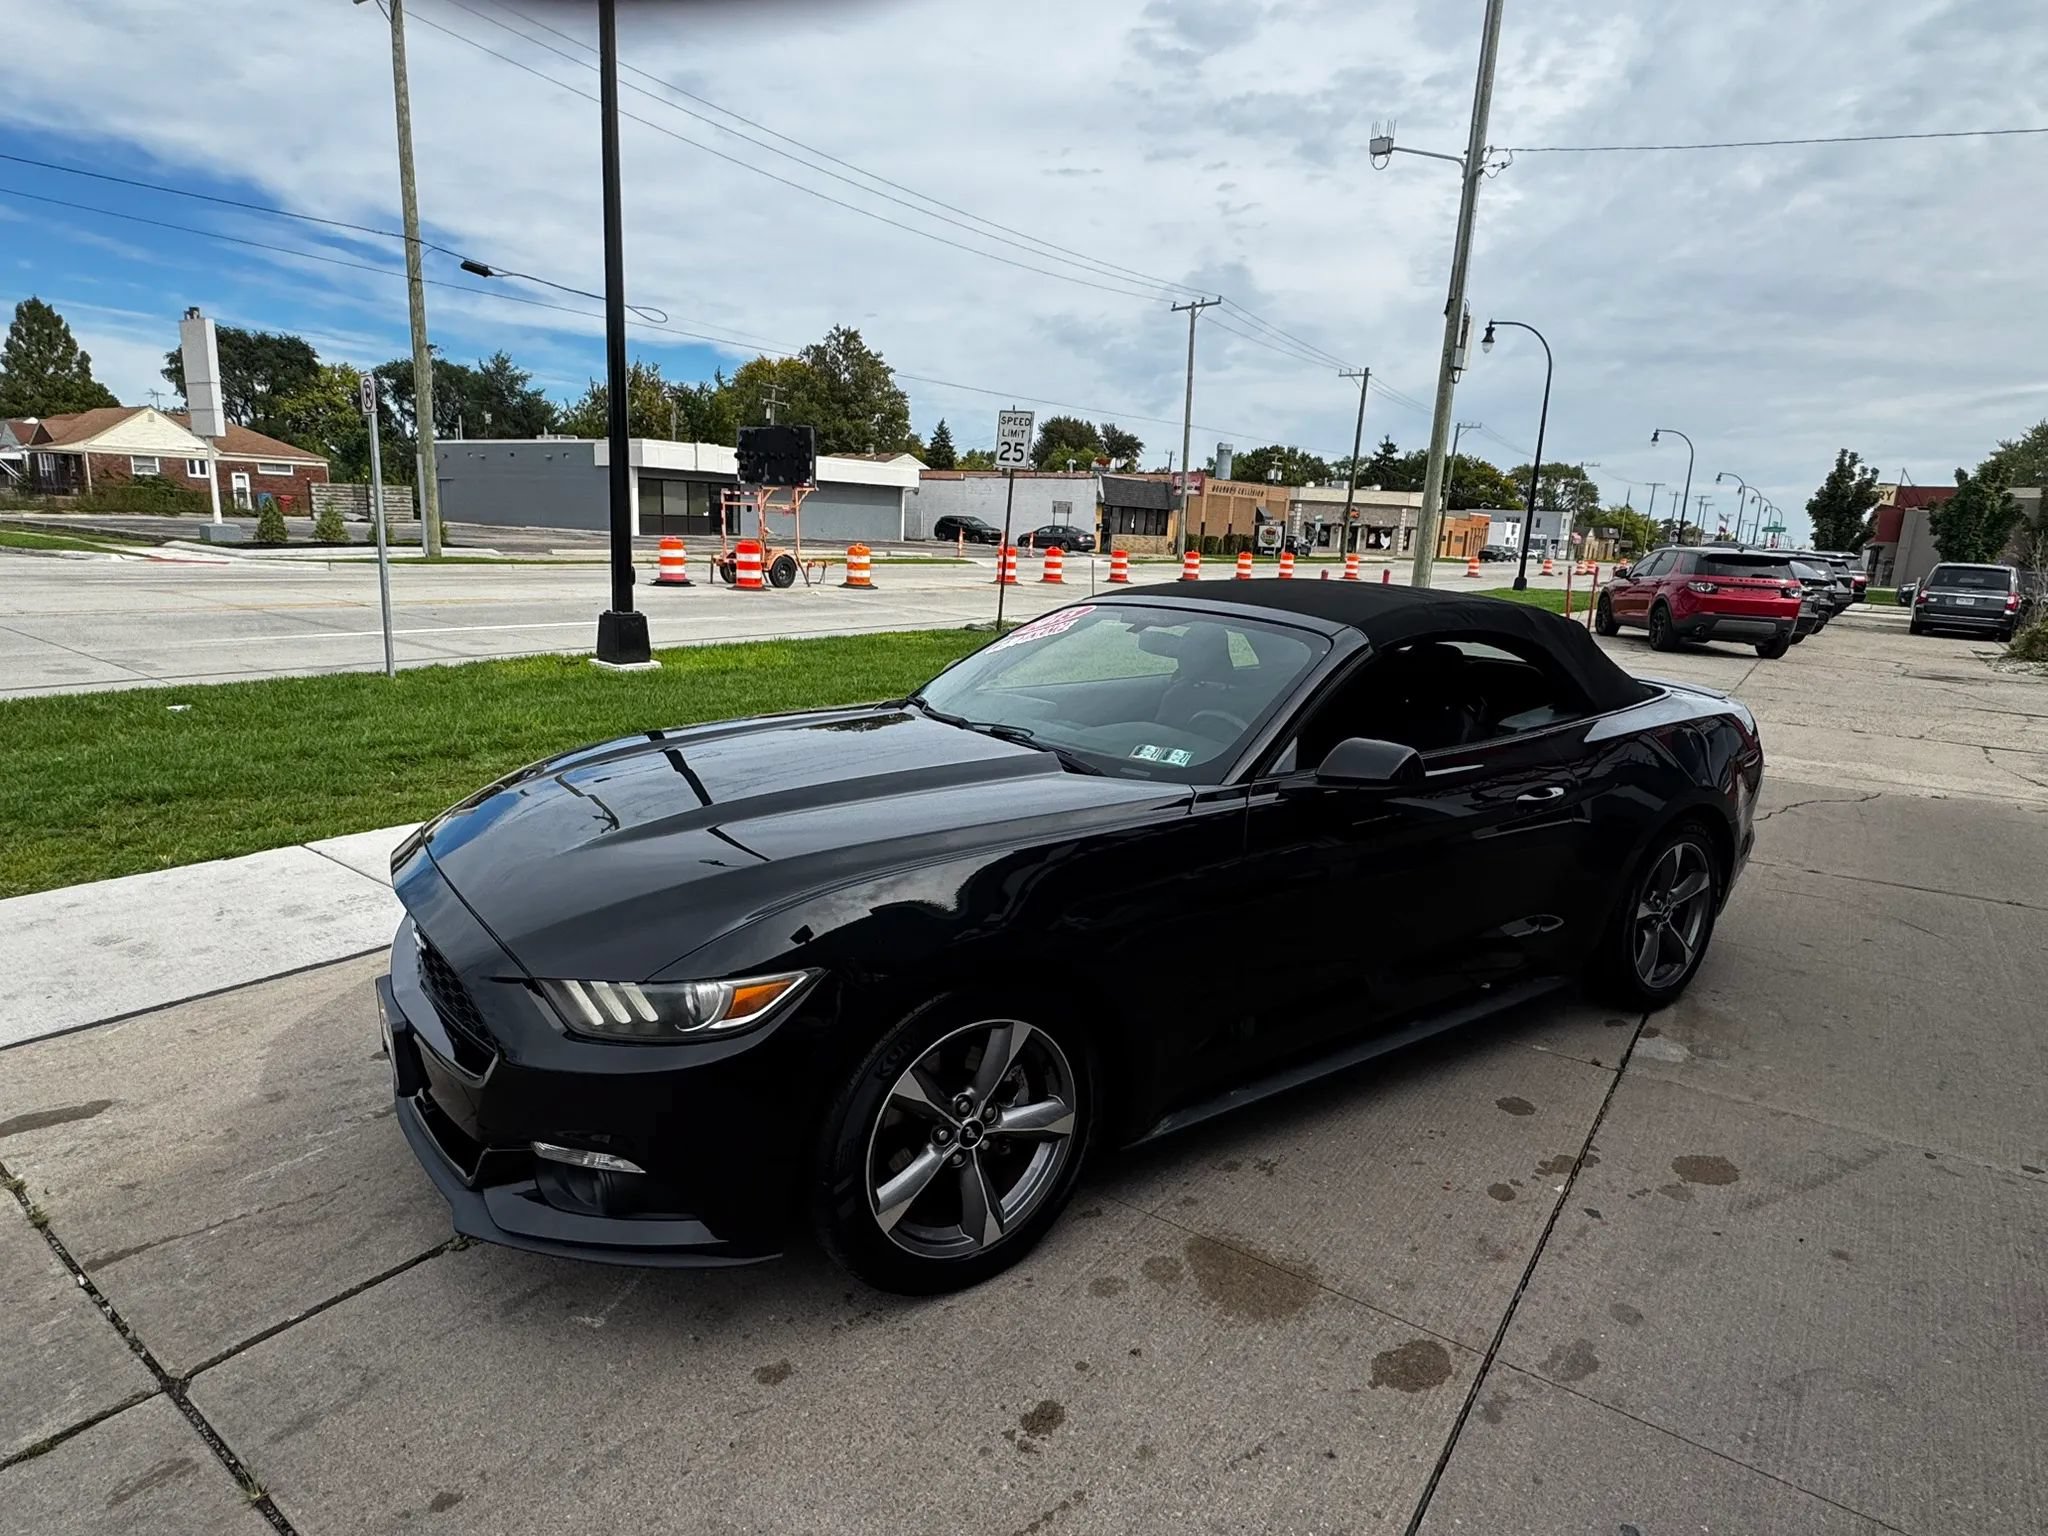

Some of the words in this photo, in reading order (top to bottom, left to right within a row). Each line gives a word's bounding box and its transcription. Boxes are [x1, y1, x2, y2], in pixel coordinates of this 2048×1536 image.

[1000, 416, 1031, 427] SPEED
[1001, 428, 1026, 439] LIMIT
[998, 441, 1025, 463] 25
